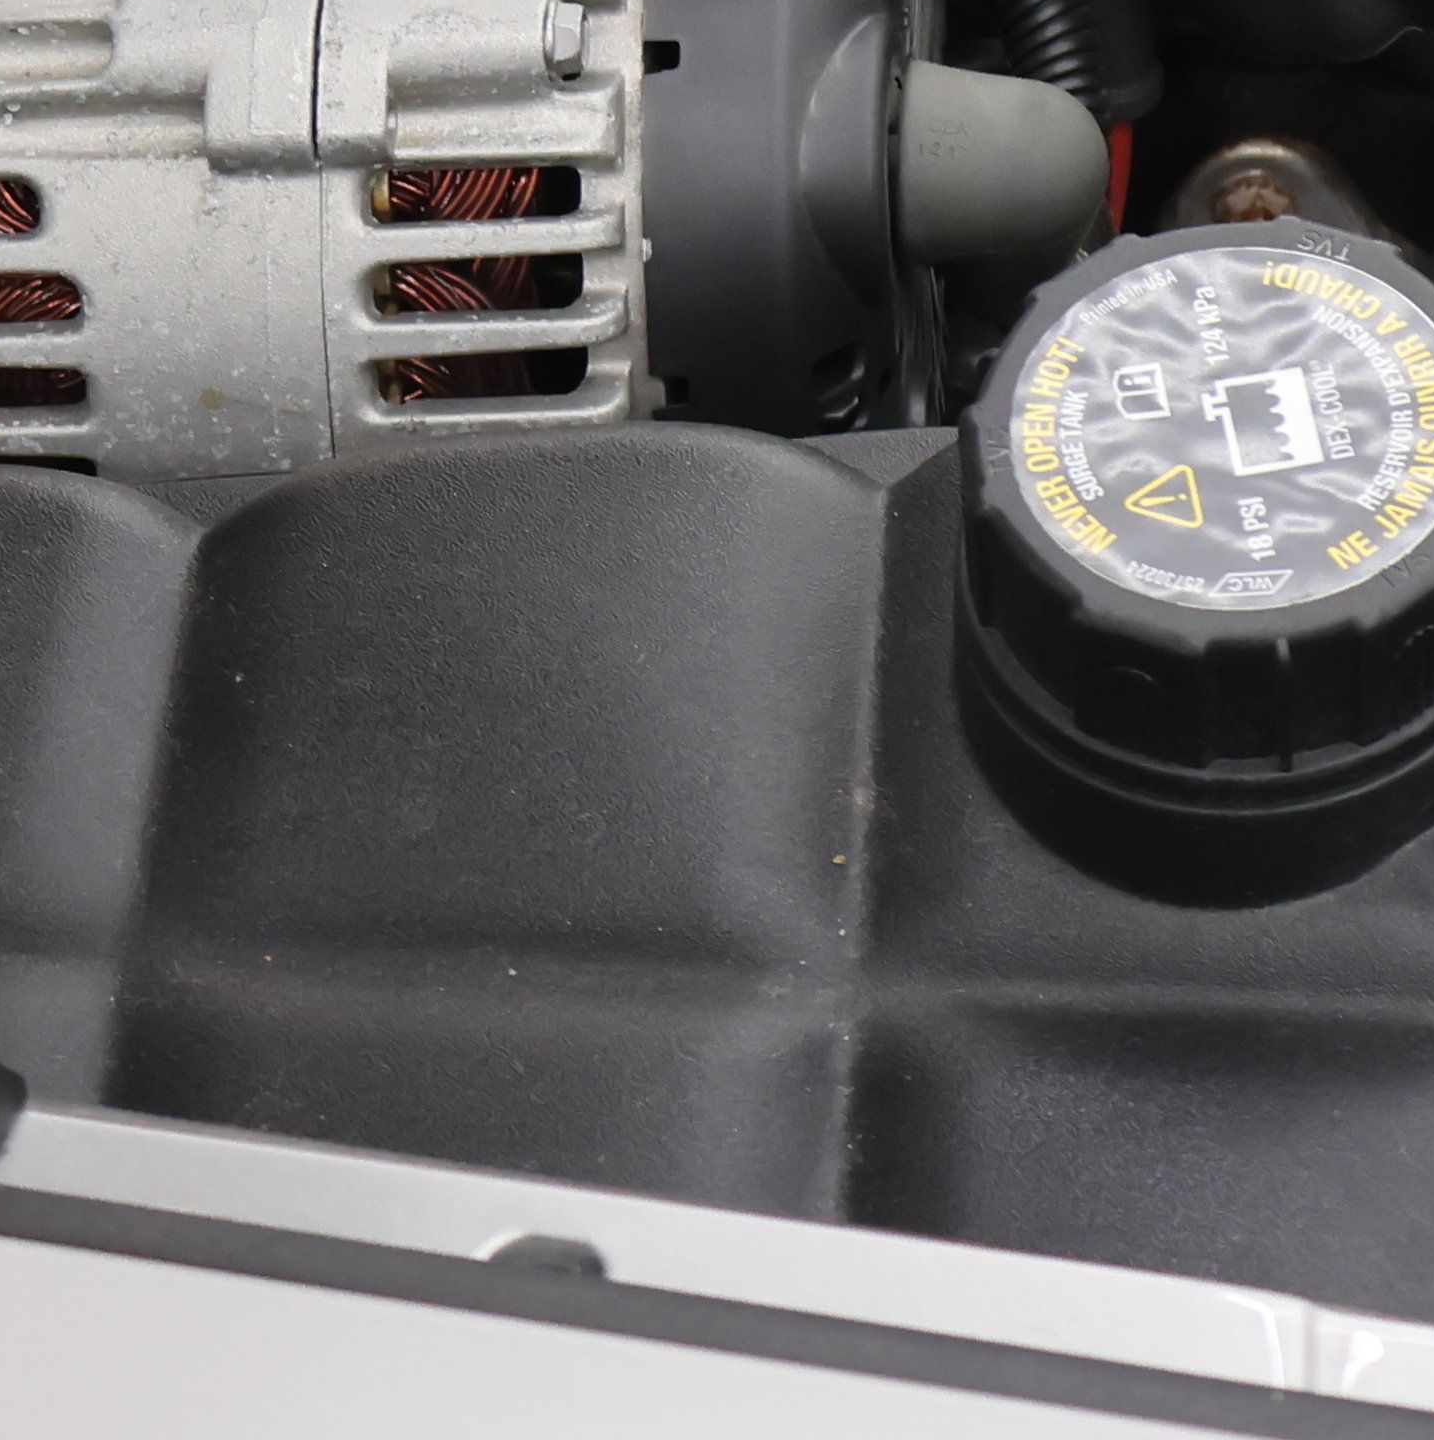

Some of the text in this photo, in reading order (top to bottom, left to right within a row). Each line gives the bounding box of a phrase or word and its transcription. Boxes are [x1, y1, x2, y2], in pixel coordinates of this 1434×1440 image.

[1297, 231, 1351, 262] TVS
[1078, 295, 1126, 326] Printed
[1262, 260, 1382, 320] CHAUD!
[1194, 284, 1230, 366] 124 kPa
[1375, 310, 1408, 336] A
[1311, 304, 1414, 512] RESERVOIR D'EXPANSION
[1022, 336, 1118, 555] NEVER OPEN HOT!
[1060, 389, 1105, 501] SURGE TANK
[1237, 495, 1276, 562] 18 PSI
[1326, 530, 1379, 571] NE
[1227, 575, 1273, 592] WLC
